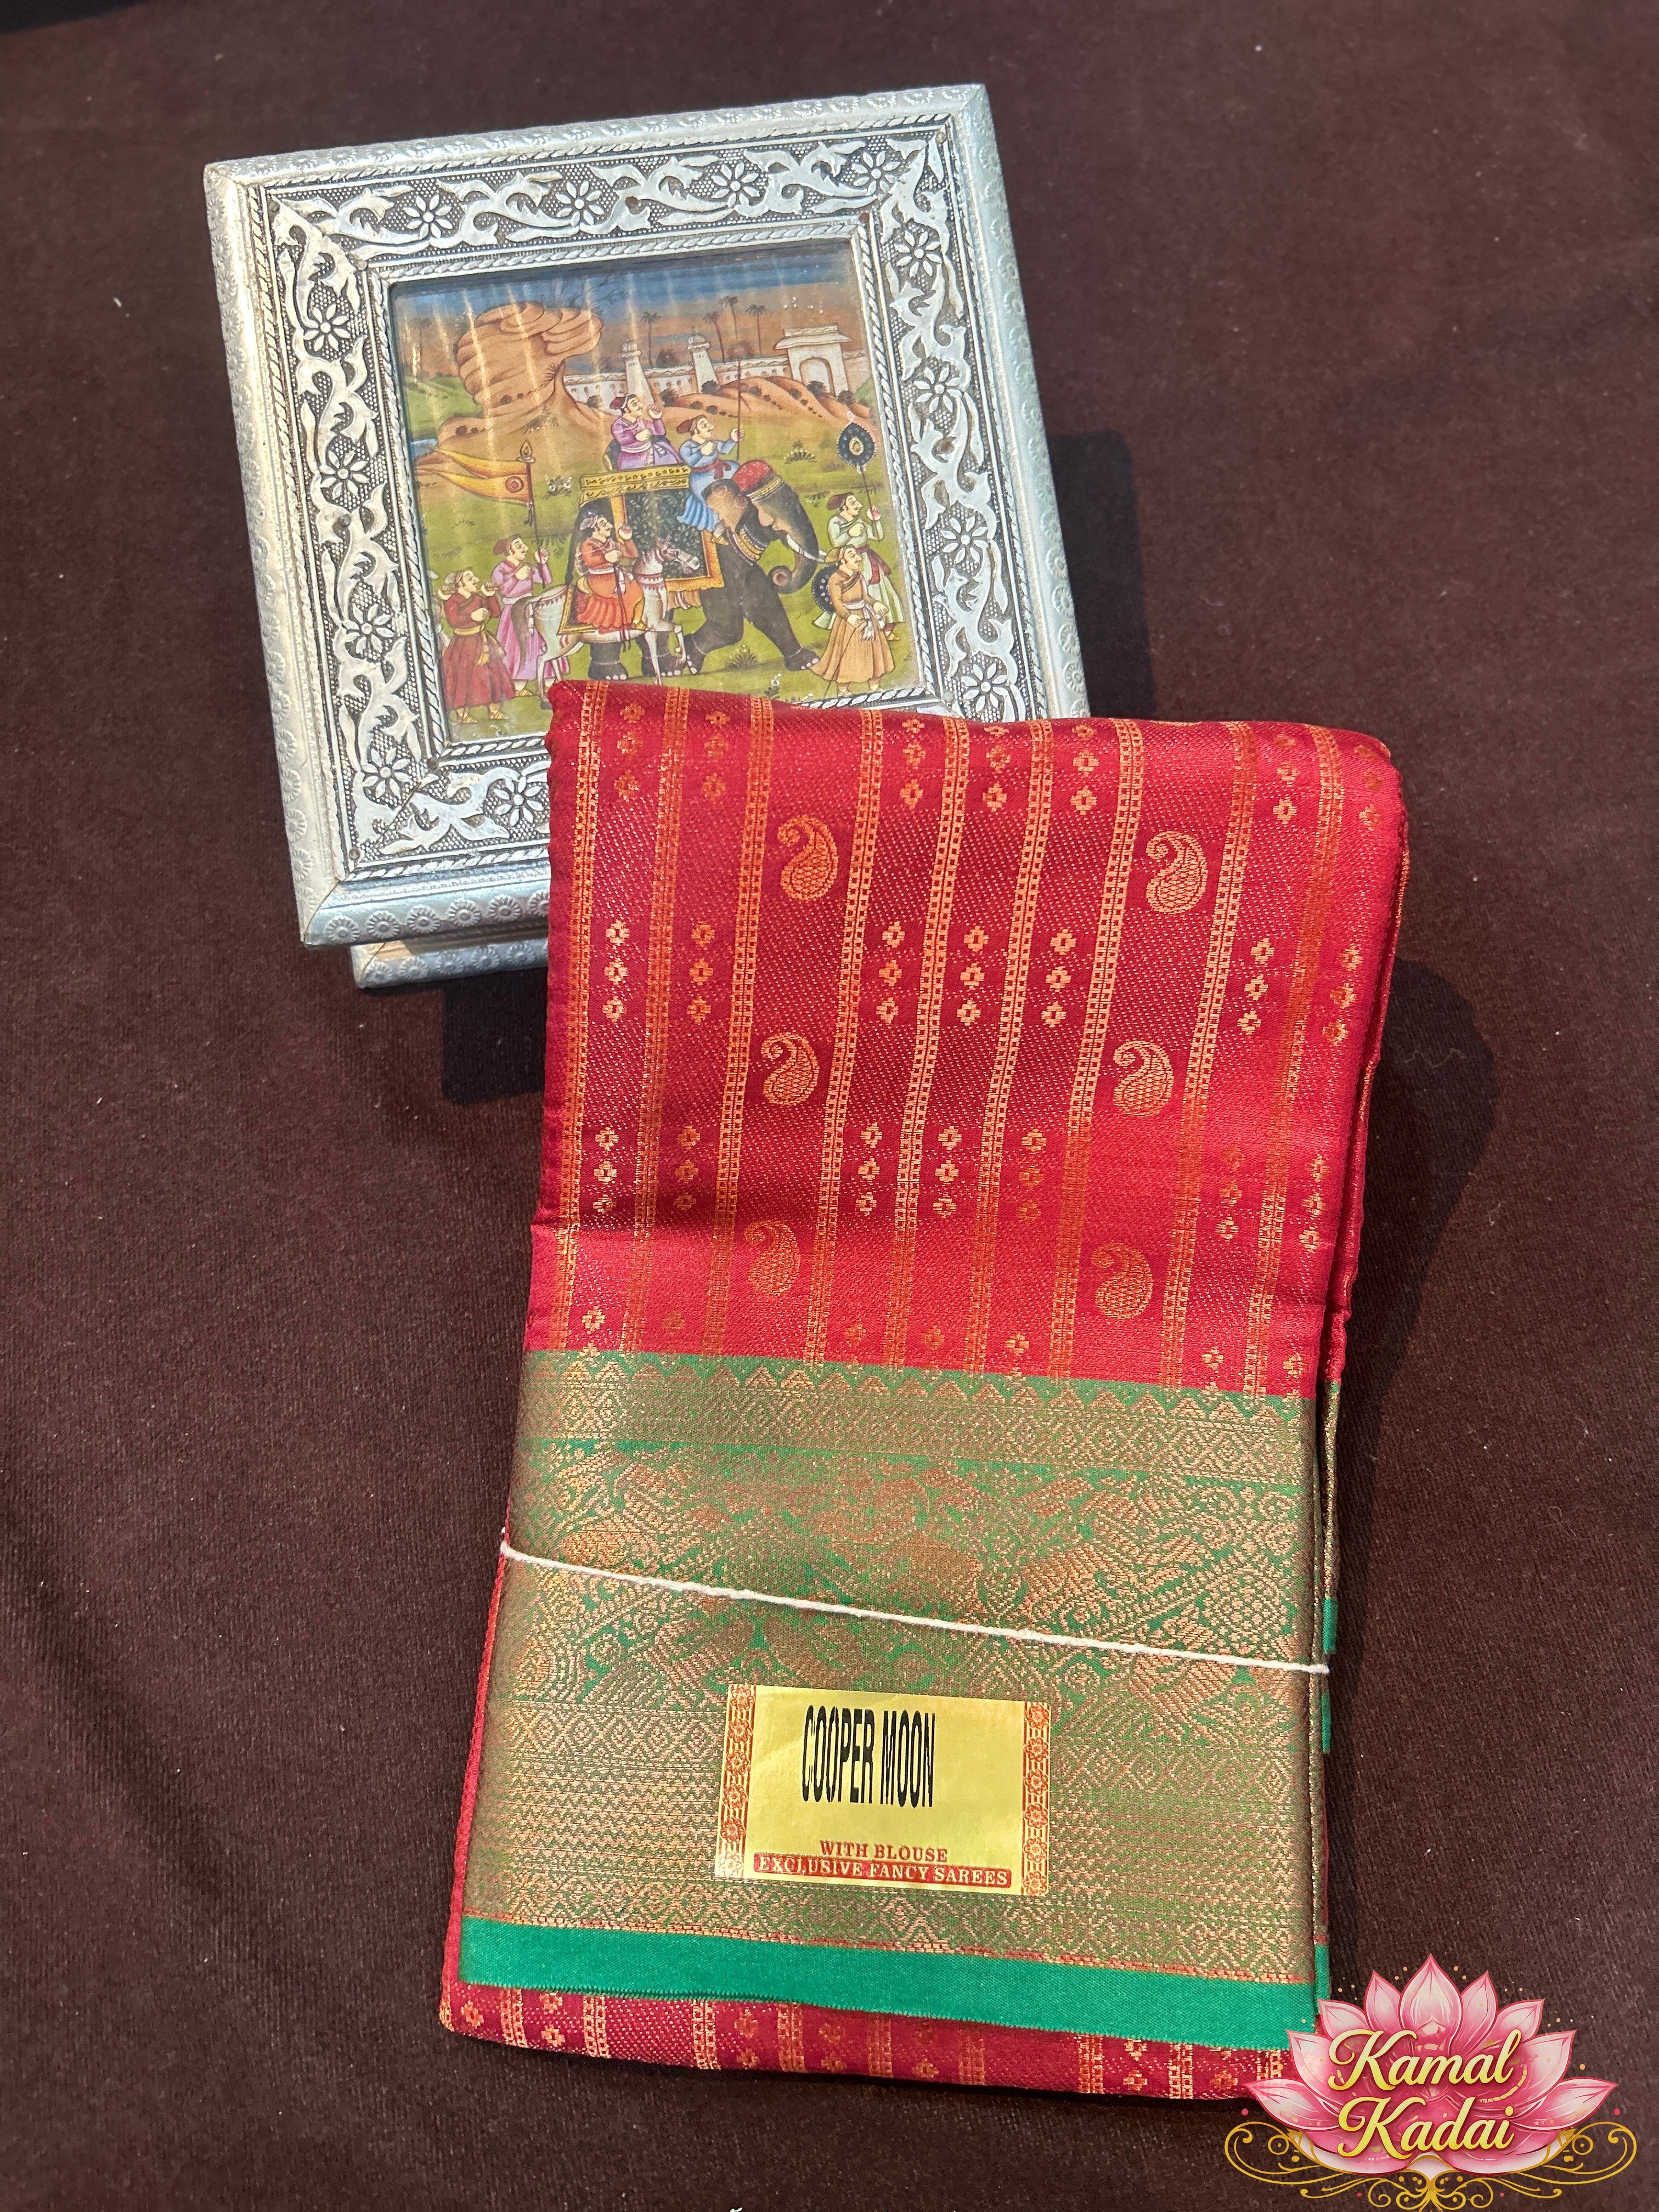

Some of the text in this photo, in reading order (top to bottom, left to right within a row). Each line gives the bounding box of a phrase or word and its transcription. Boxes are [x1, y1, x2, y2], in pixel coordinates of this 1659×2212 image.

[802, 1705, 935, 1808] COOPER MOON
[819, 1840, 948, 1863] WITH BLOUSE
[759, 1855, 1008, 1886] EXCLUSIVE FANCY SAREES
